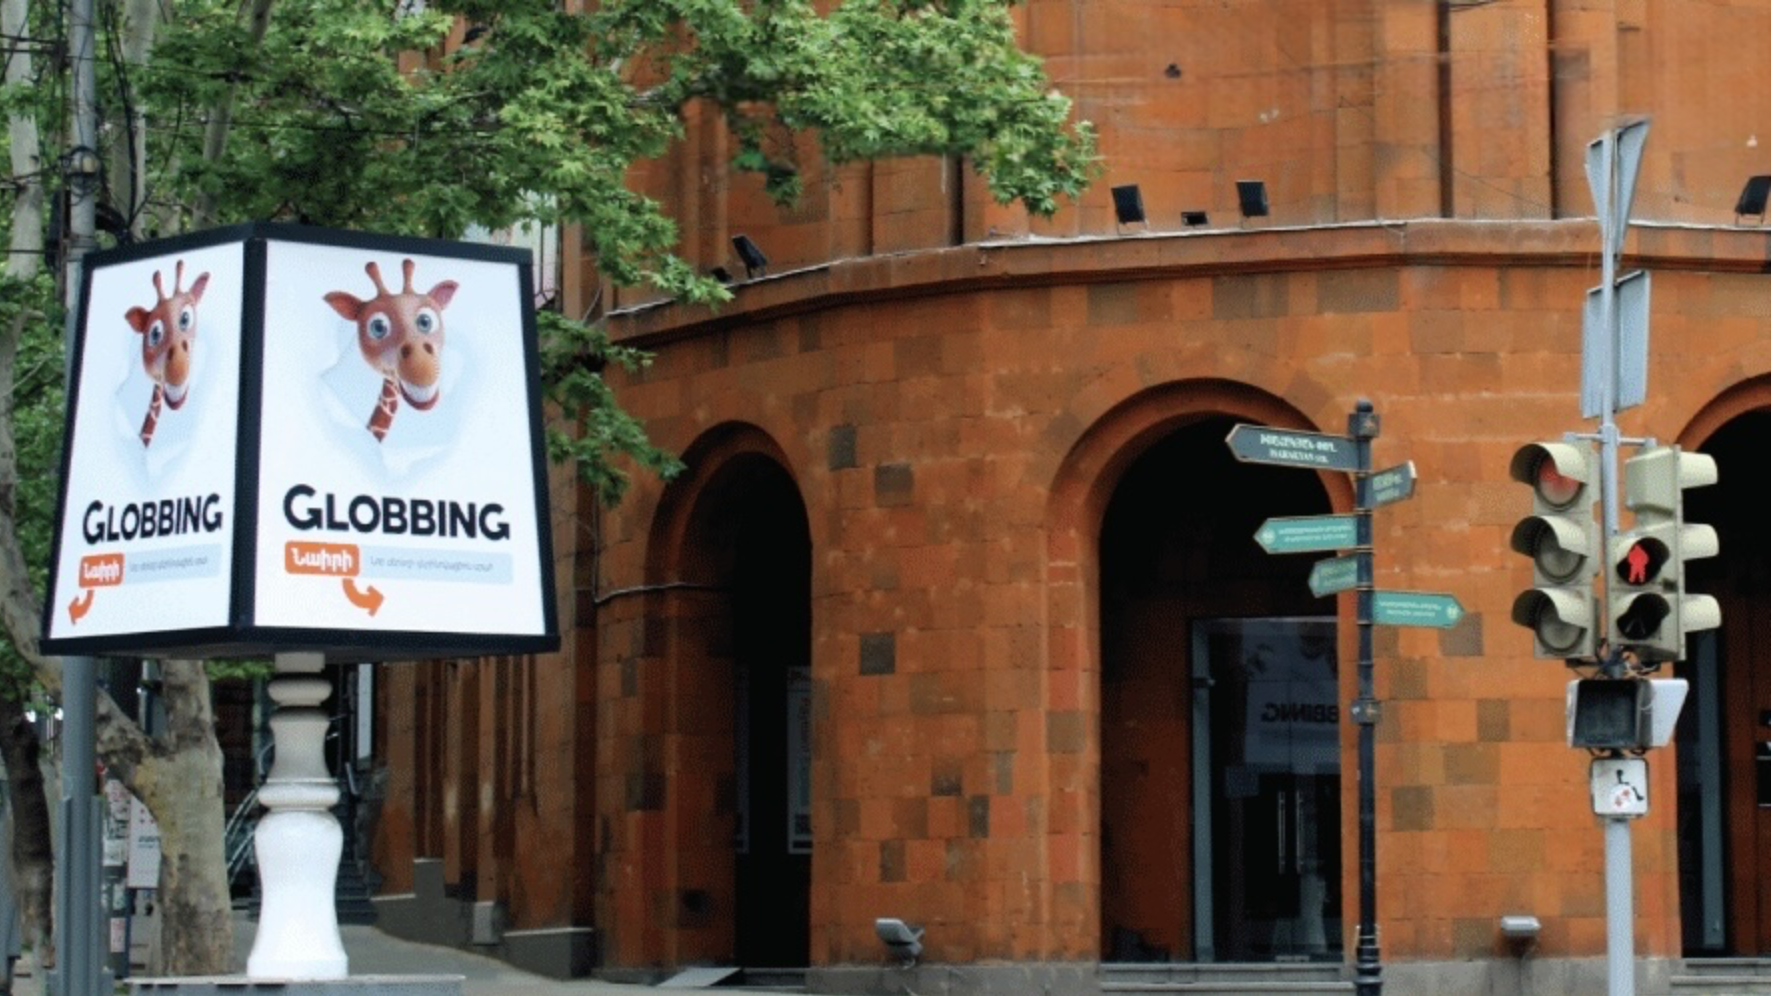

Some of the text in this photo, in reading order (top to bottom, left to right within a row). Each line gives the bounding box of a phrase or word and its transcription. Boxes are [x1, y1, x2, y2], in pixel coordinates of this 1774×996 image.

[83, 493, 222, 545] GLOBBING
[283, 484, 510, 541] GLOBBING
[291, 547, 352, 572] Նաիրի
